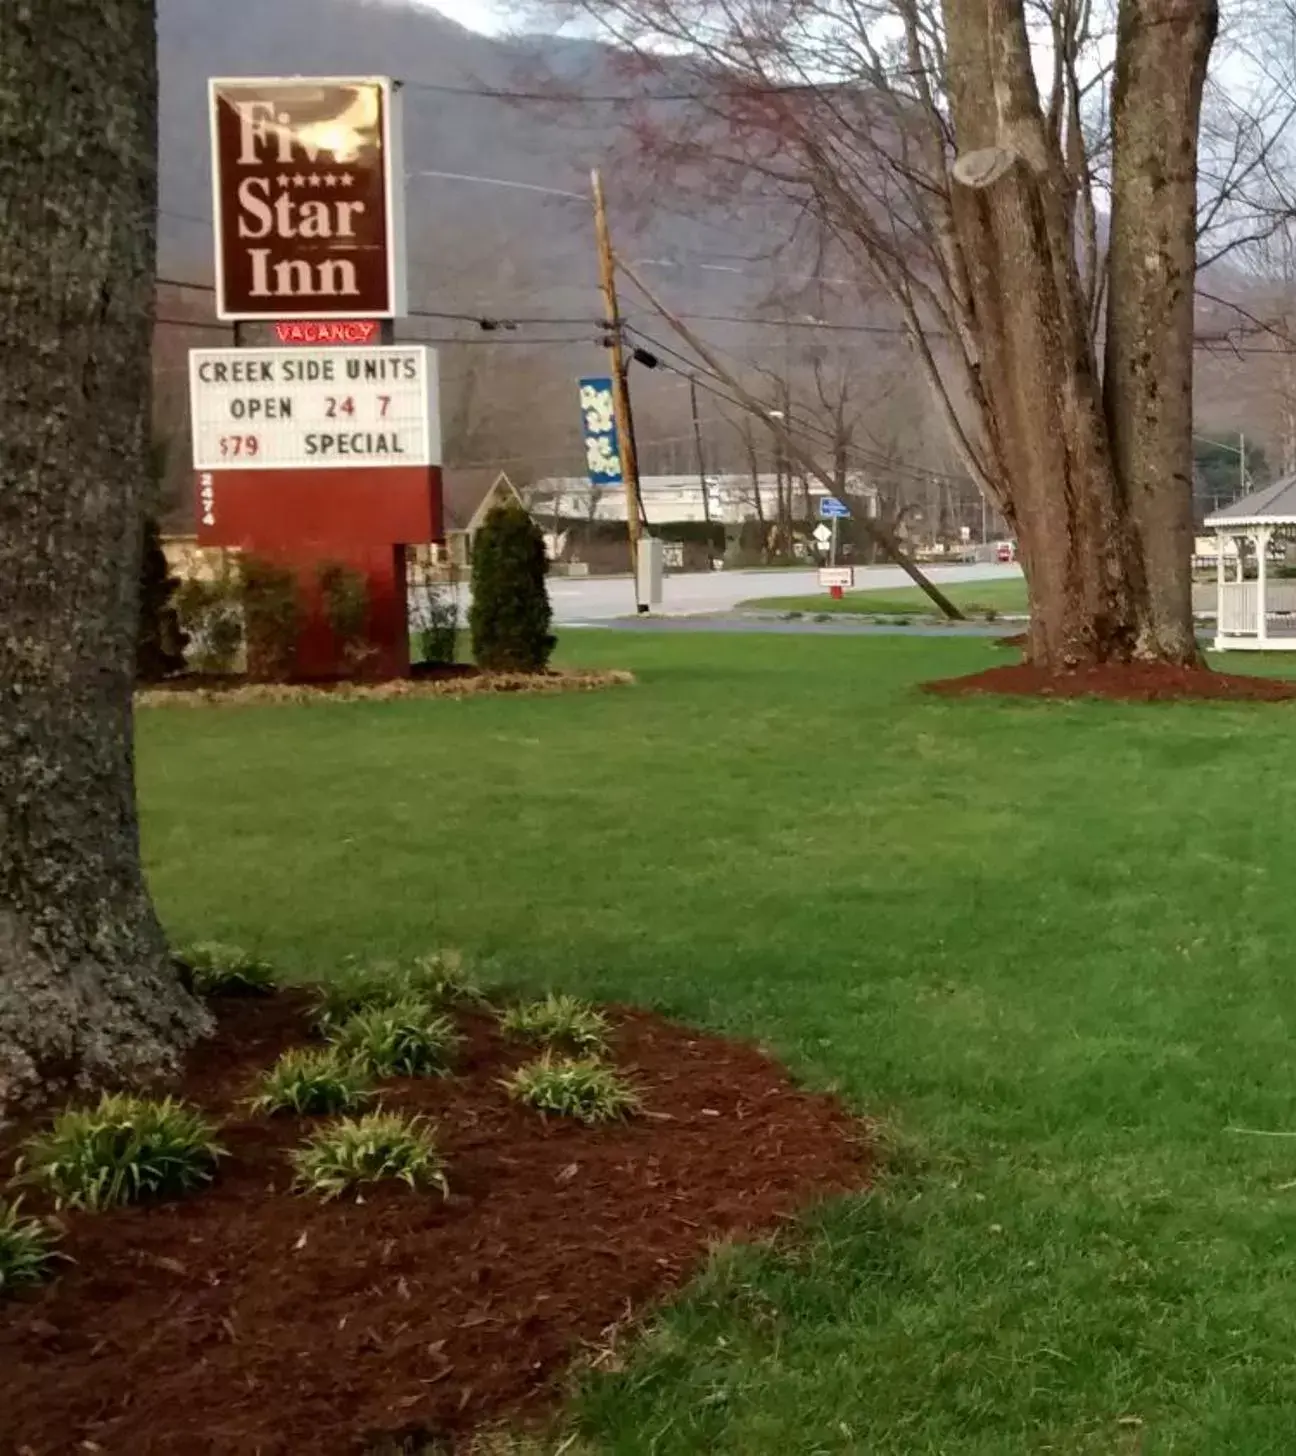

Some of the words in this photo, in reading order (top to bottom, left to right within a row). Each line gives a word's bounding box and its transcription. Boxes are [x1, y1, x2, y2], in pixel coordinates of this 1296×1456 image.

[237, 176, 366, 239] Star
[247, 248, 360, 297] Inn
[275, 321, 375, 342] VACANCY
[199, 361, 274, 383] CREEK
[281, 359, 334, 382] SIDE
[346, 357, 416, 380] UNITS
[229, 397, 293, 420] OPEN
[325, 396, 355, 417] 24
[378, 395, 391, 417] 7
[219, 434, 259, 457] $79
[304, 432, 405, 454] SPECIAL
